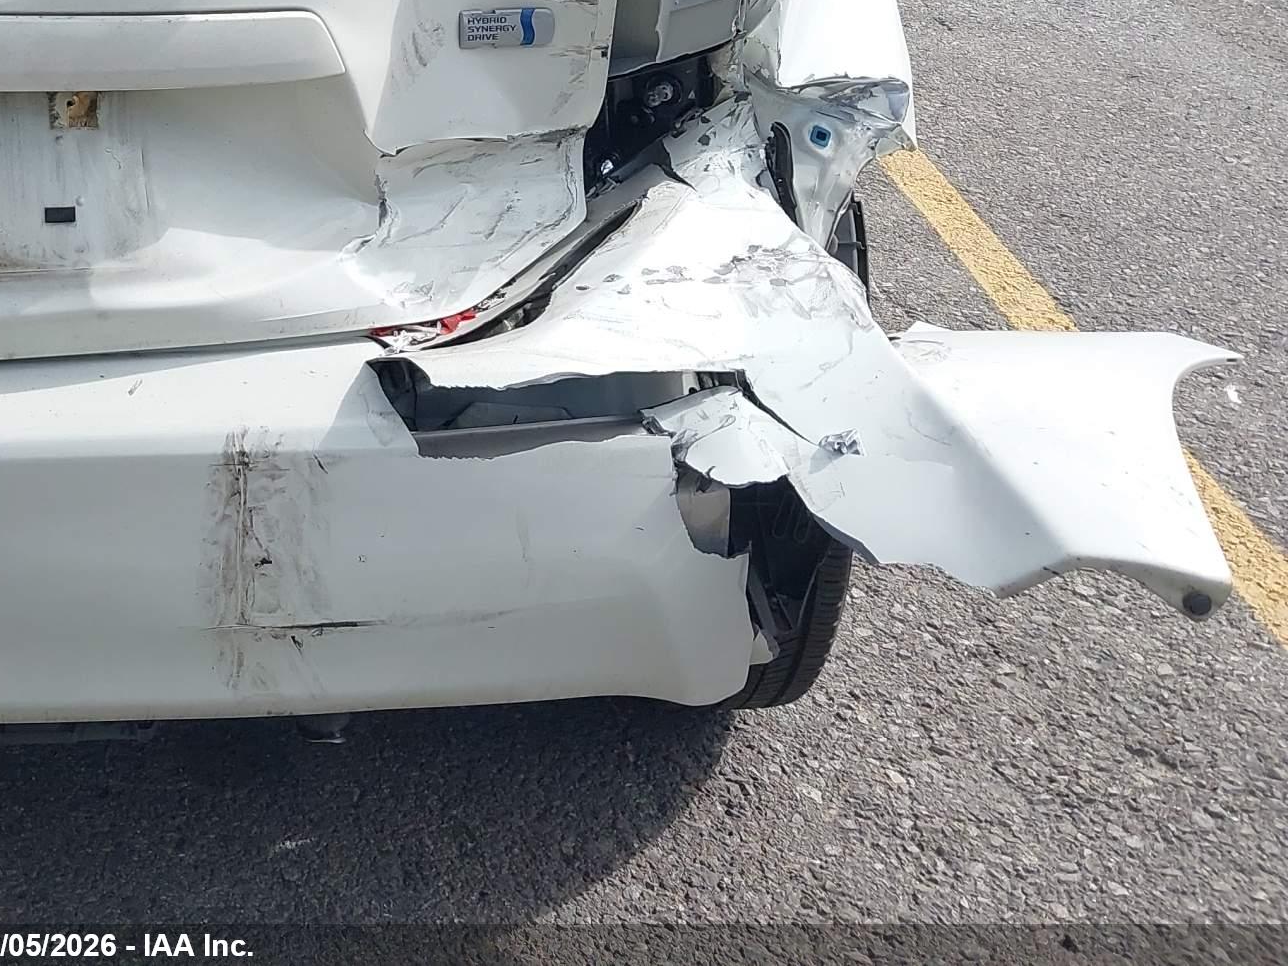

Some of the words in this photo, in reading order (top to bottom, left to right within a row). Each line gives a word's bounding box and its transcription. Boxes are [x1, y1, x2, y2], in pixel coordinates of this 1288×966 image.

[467, 16, 507, 25] HYBRID
[467, 24, 517, 33] SYNERGY
[467, 33, 499, 42] DRIVE
